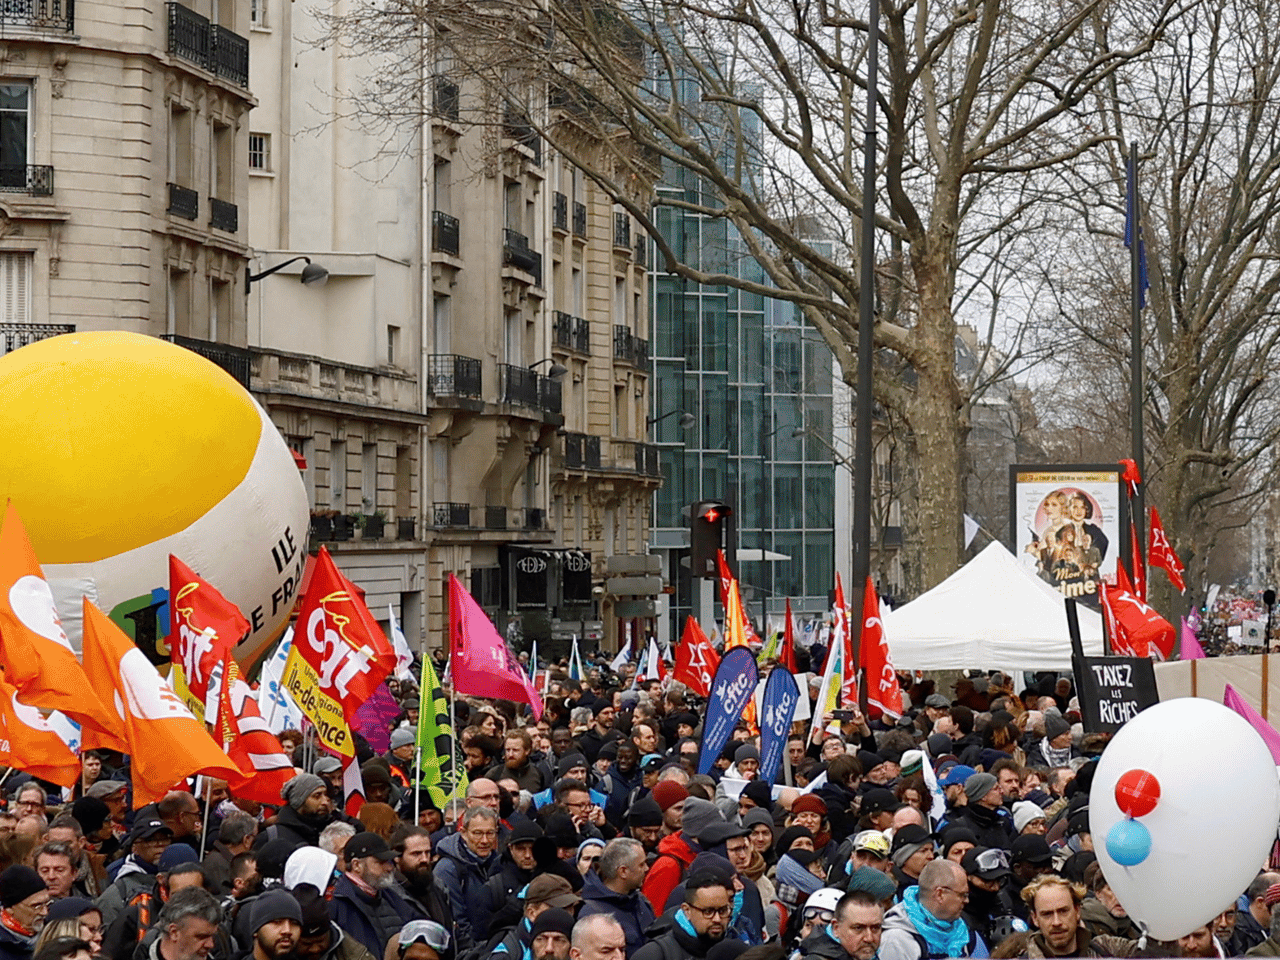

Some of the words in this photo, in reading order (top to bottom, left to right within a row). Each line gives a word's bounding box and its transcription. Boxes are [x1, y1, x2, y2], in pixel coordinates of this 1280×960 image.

[271, 527, 297, 573] ILE
[308, 607, 372, 700] cgt
[1091, 664, 1134, 688] TAXEZ
[774, 692, 791, 737] cftc
[1111, 689, 1123, 699] LES
